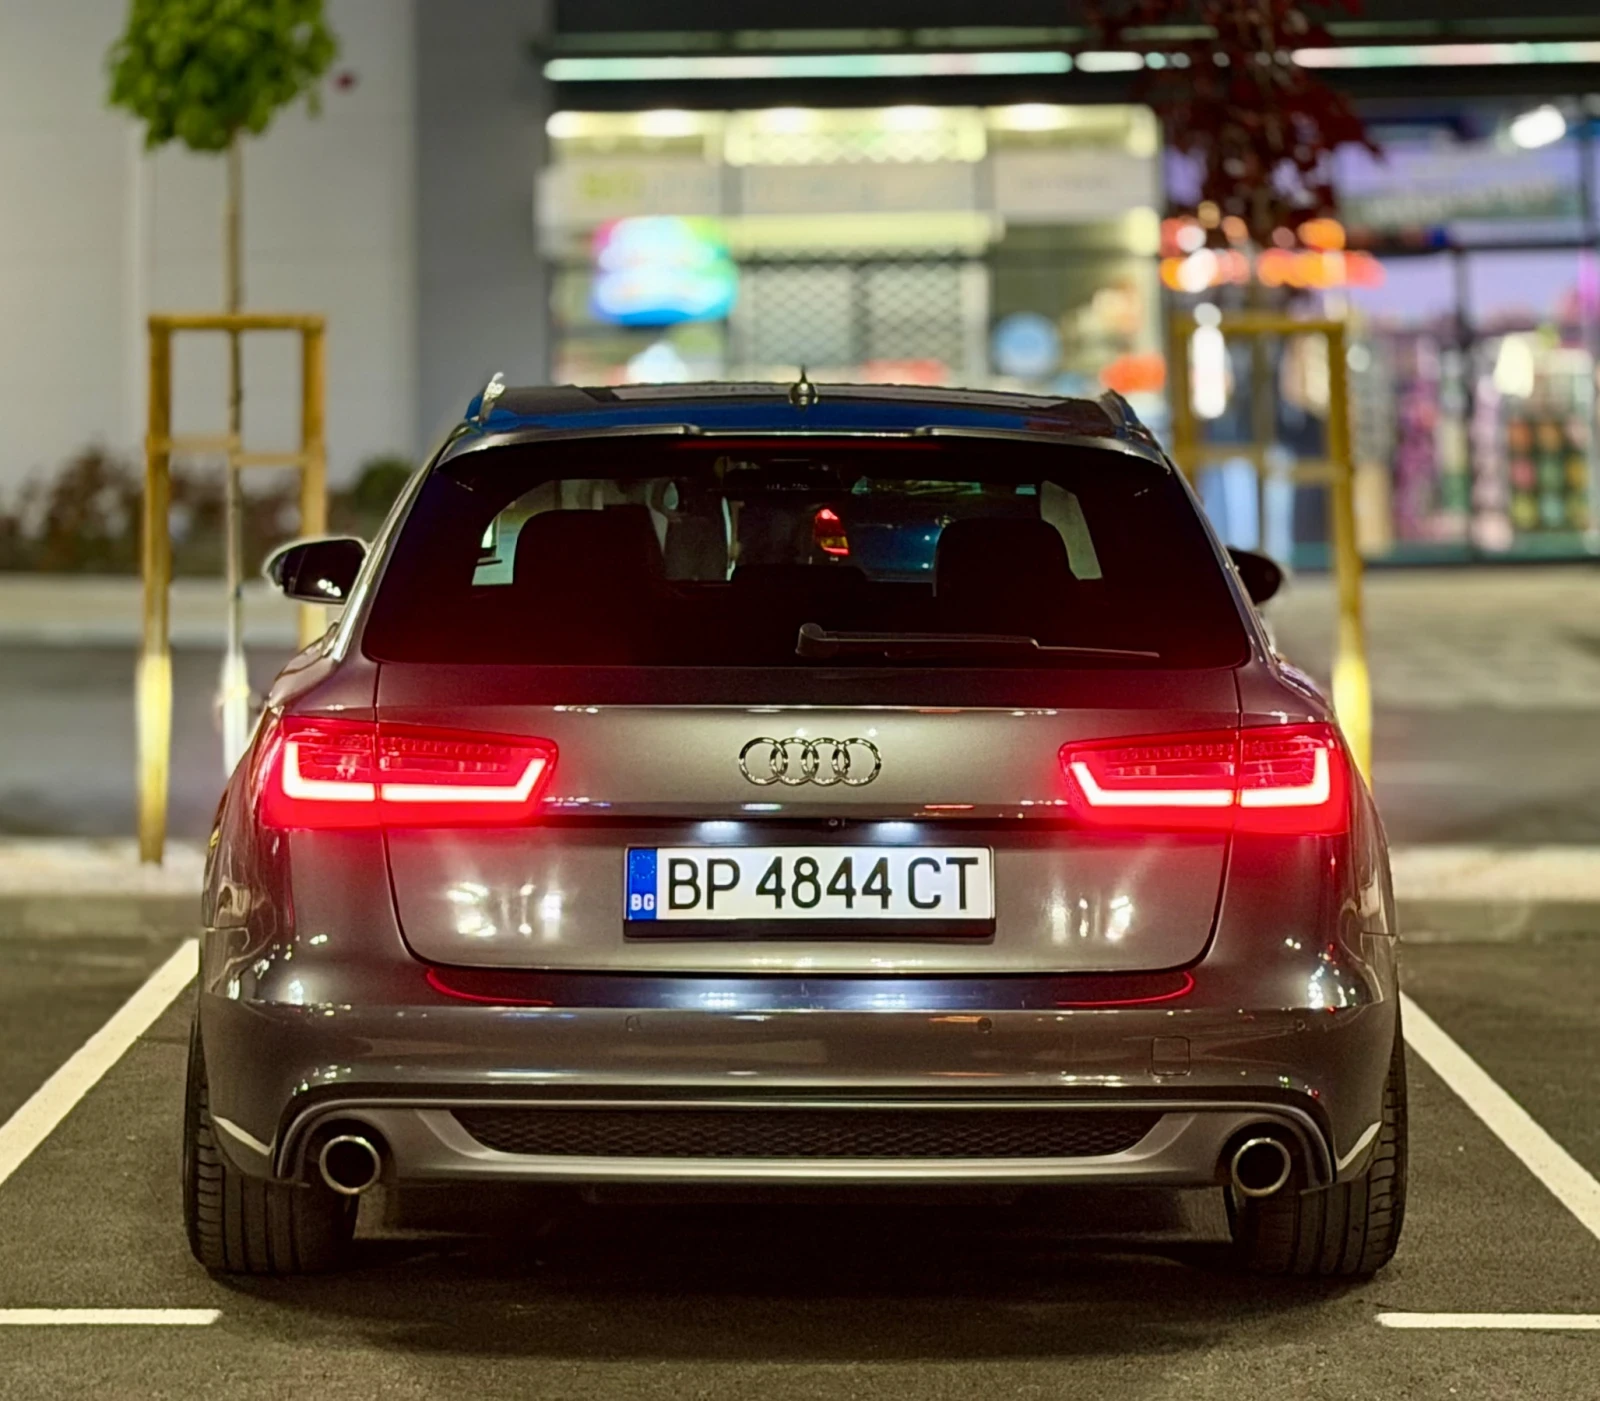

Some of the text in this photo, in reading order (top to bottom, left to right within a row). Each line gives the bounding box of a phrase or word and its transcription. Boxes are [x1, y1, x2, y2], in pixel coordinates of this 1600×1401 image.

[668, 856, 979, 910] BP 4844 CT
[631, 893, 655, 911] BG
